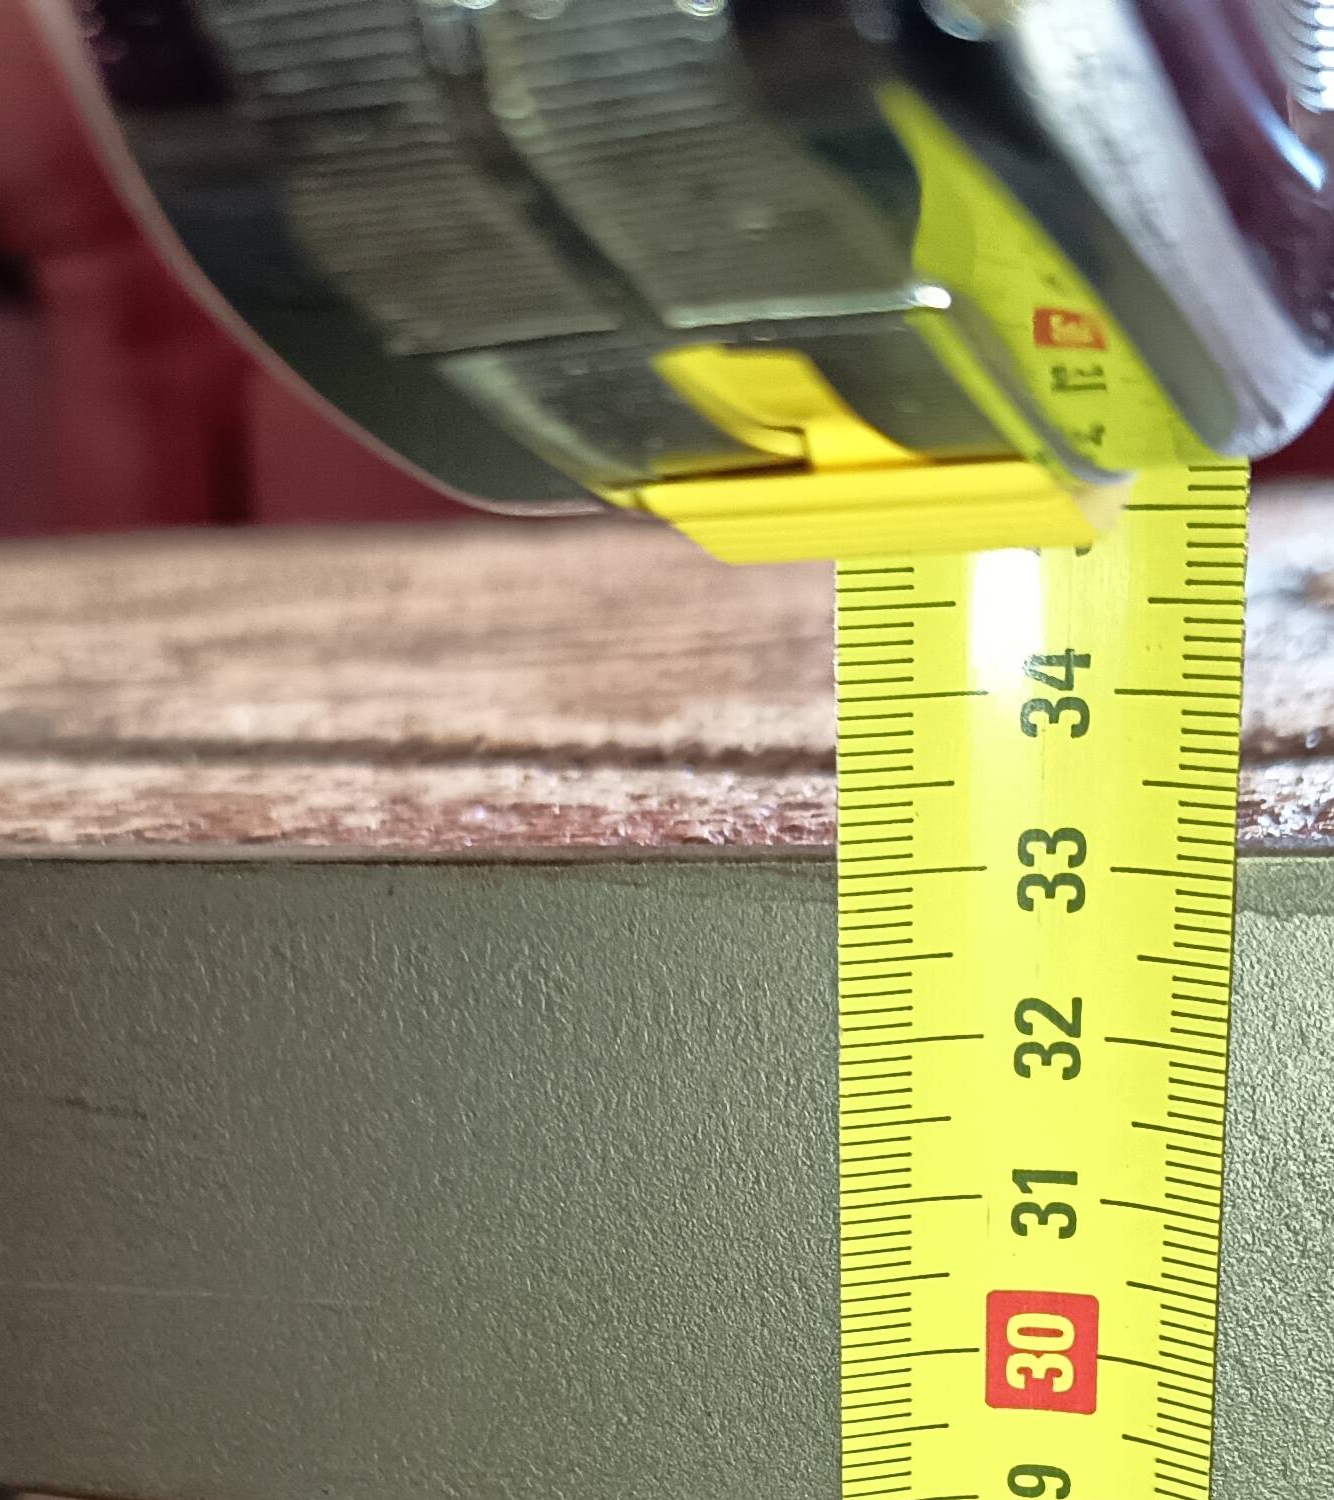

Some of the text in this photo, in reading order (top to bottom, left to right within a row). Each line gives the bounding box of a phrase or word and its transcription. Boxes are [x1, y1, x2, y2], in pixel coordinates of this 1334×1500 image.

[1019, 647, 1092, 739] 34
[1017, 827, 1088, 914] 33
[1013, 996, 1083, 1081] 32
[1010, 1168, 1079, 1240] 31
[1006, 1312, 1076, 1393] 30
